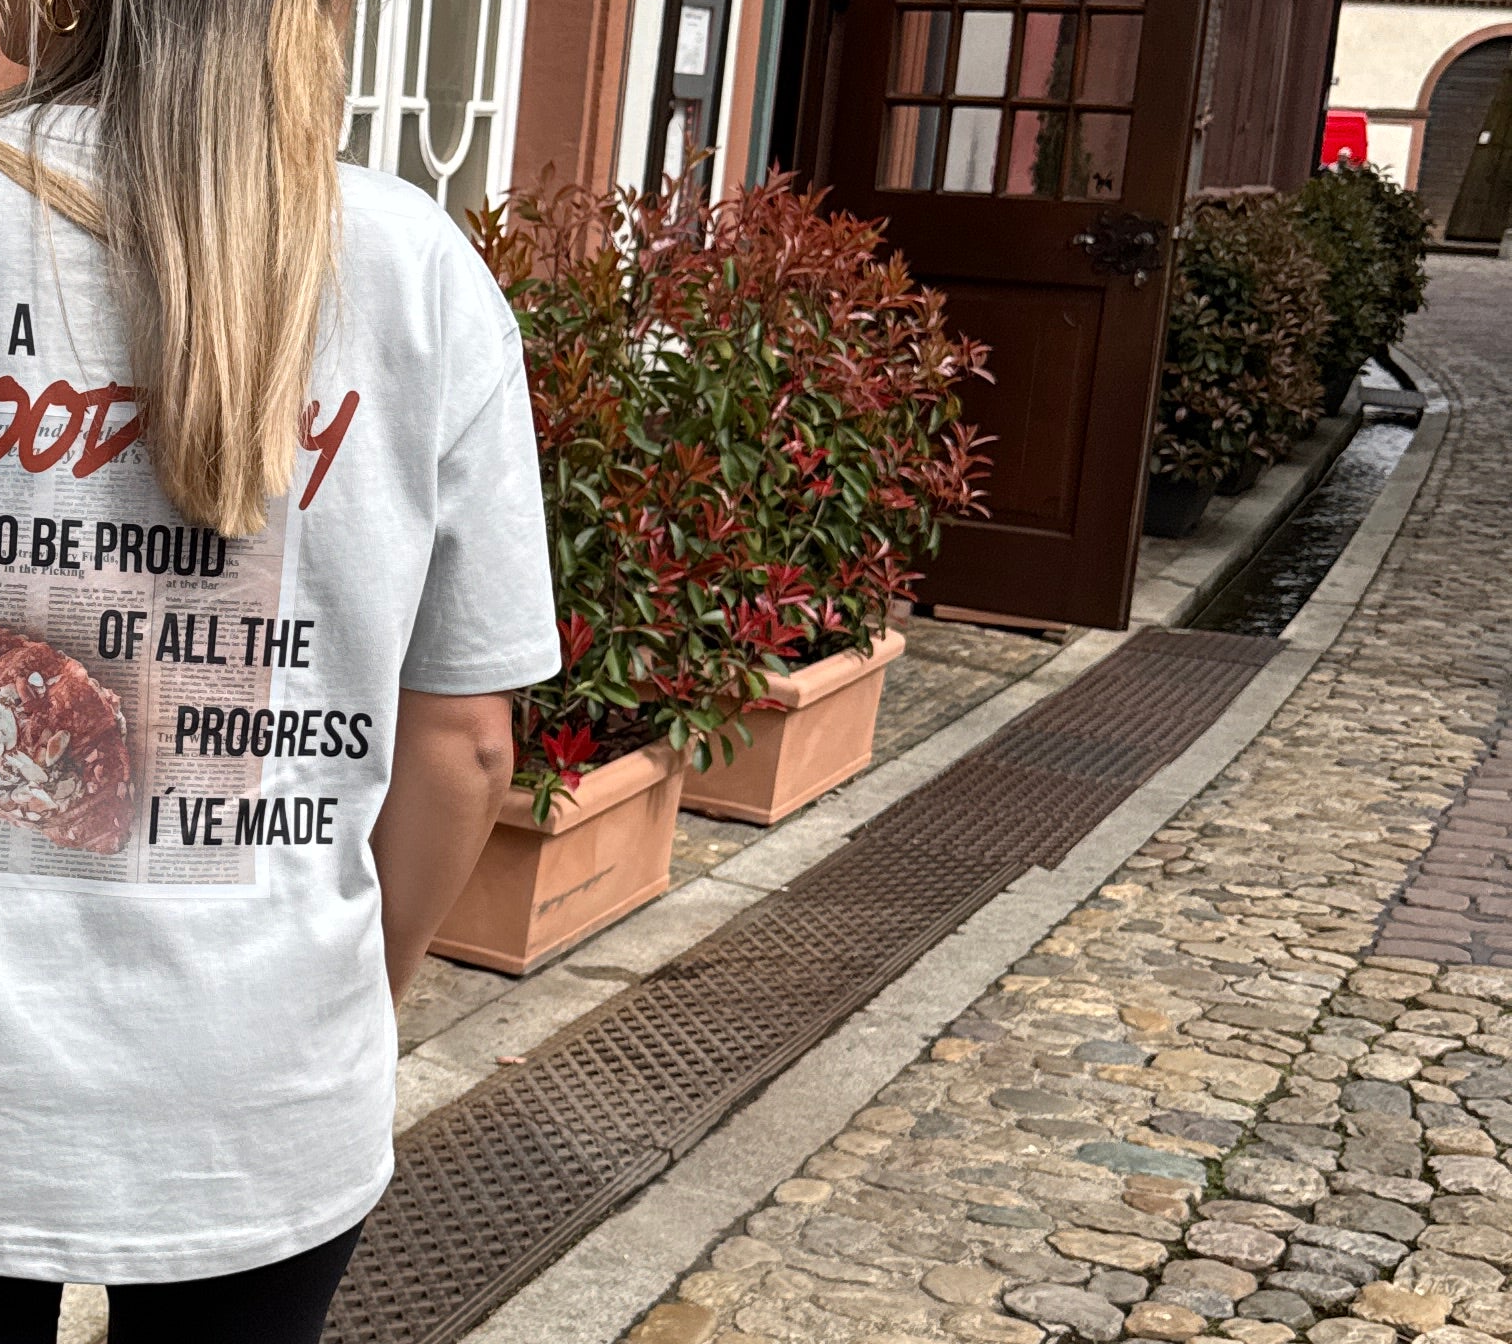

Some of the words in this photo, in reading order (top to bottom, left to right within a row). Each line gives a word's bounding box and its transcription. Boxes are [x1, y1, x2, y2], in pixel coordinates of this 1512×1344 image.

[8, 303, 35, 356] A
[31, 517, 83, 570] BE
[94, 522, 226, 577] PROUD
[98, 609, 147, 660] OF
[155, 612, 227, 664] ALL
[241, 617, 315, 668] THE
[175, 705, 373, 759] PROGRESS
[235, 797, 338, 845] MADE
